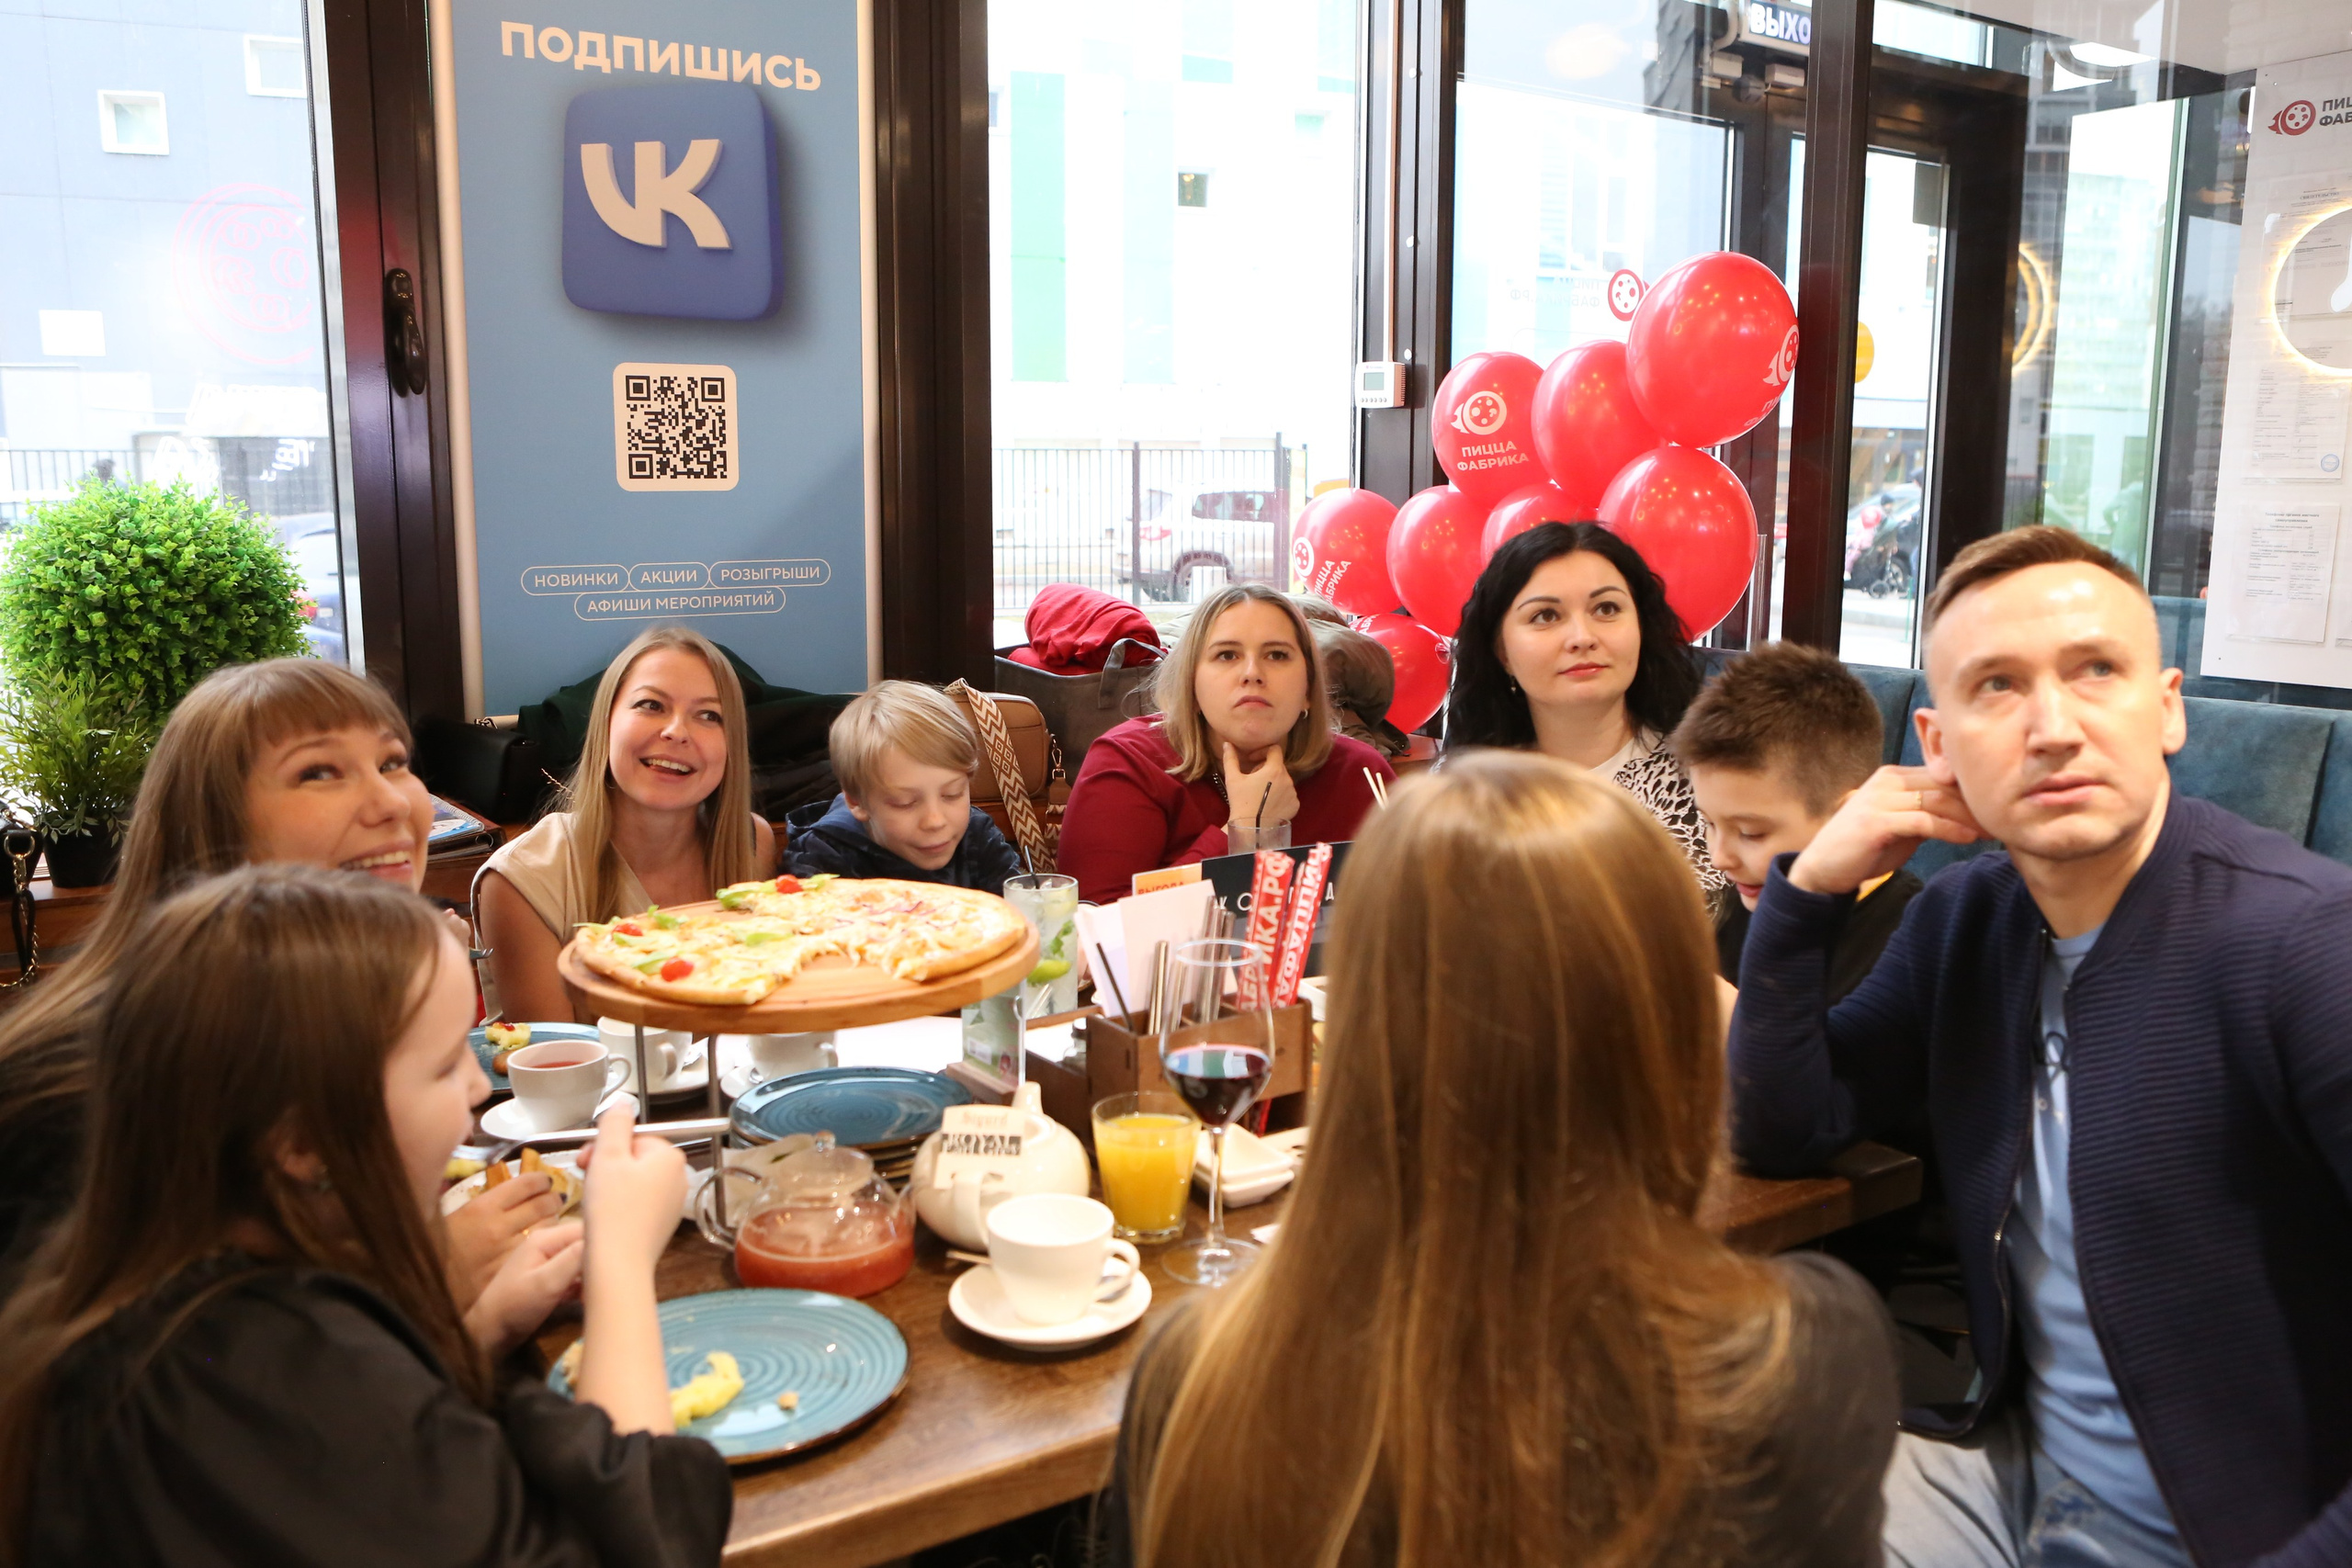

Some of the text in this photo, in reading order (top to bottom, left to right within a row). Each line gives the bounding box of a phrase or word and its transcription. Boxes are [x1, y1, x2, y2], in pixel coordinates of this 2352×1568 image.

[1750, 3, 1811, 44] ВЫХО
[501, 20, 821, 91] ПОДПИШИСЬ
[2319, 111, 2352, 126] ФАБ
[581, 139, 733, 251] VK
[1462, 441, 1517, 457] ПИЦЦА
[1457, 453, 1529, 471] ФАБРИКА
[535, 566, 820, 588] НОВИНКИ АКЦИИ РОЗЫГРЫШИ
[1325, 560, 1351, 604] АБРИКА
[587, 591, 775, 613] АФИШИ МЕРОПРИЯТИЙ
